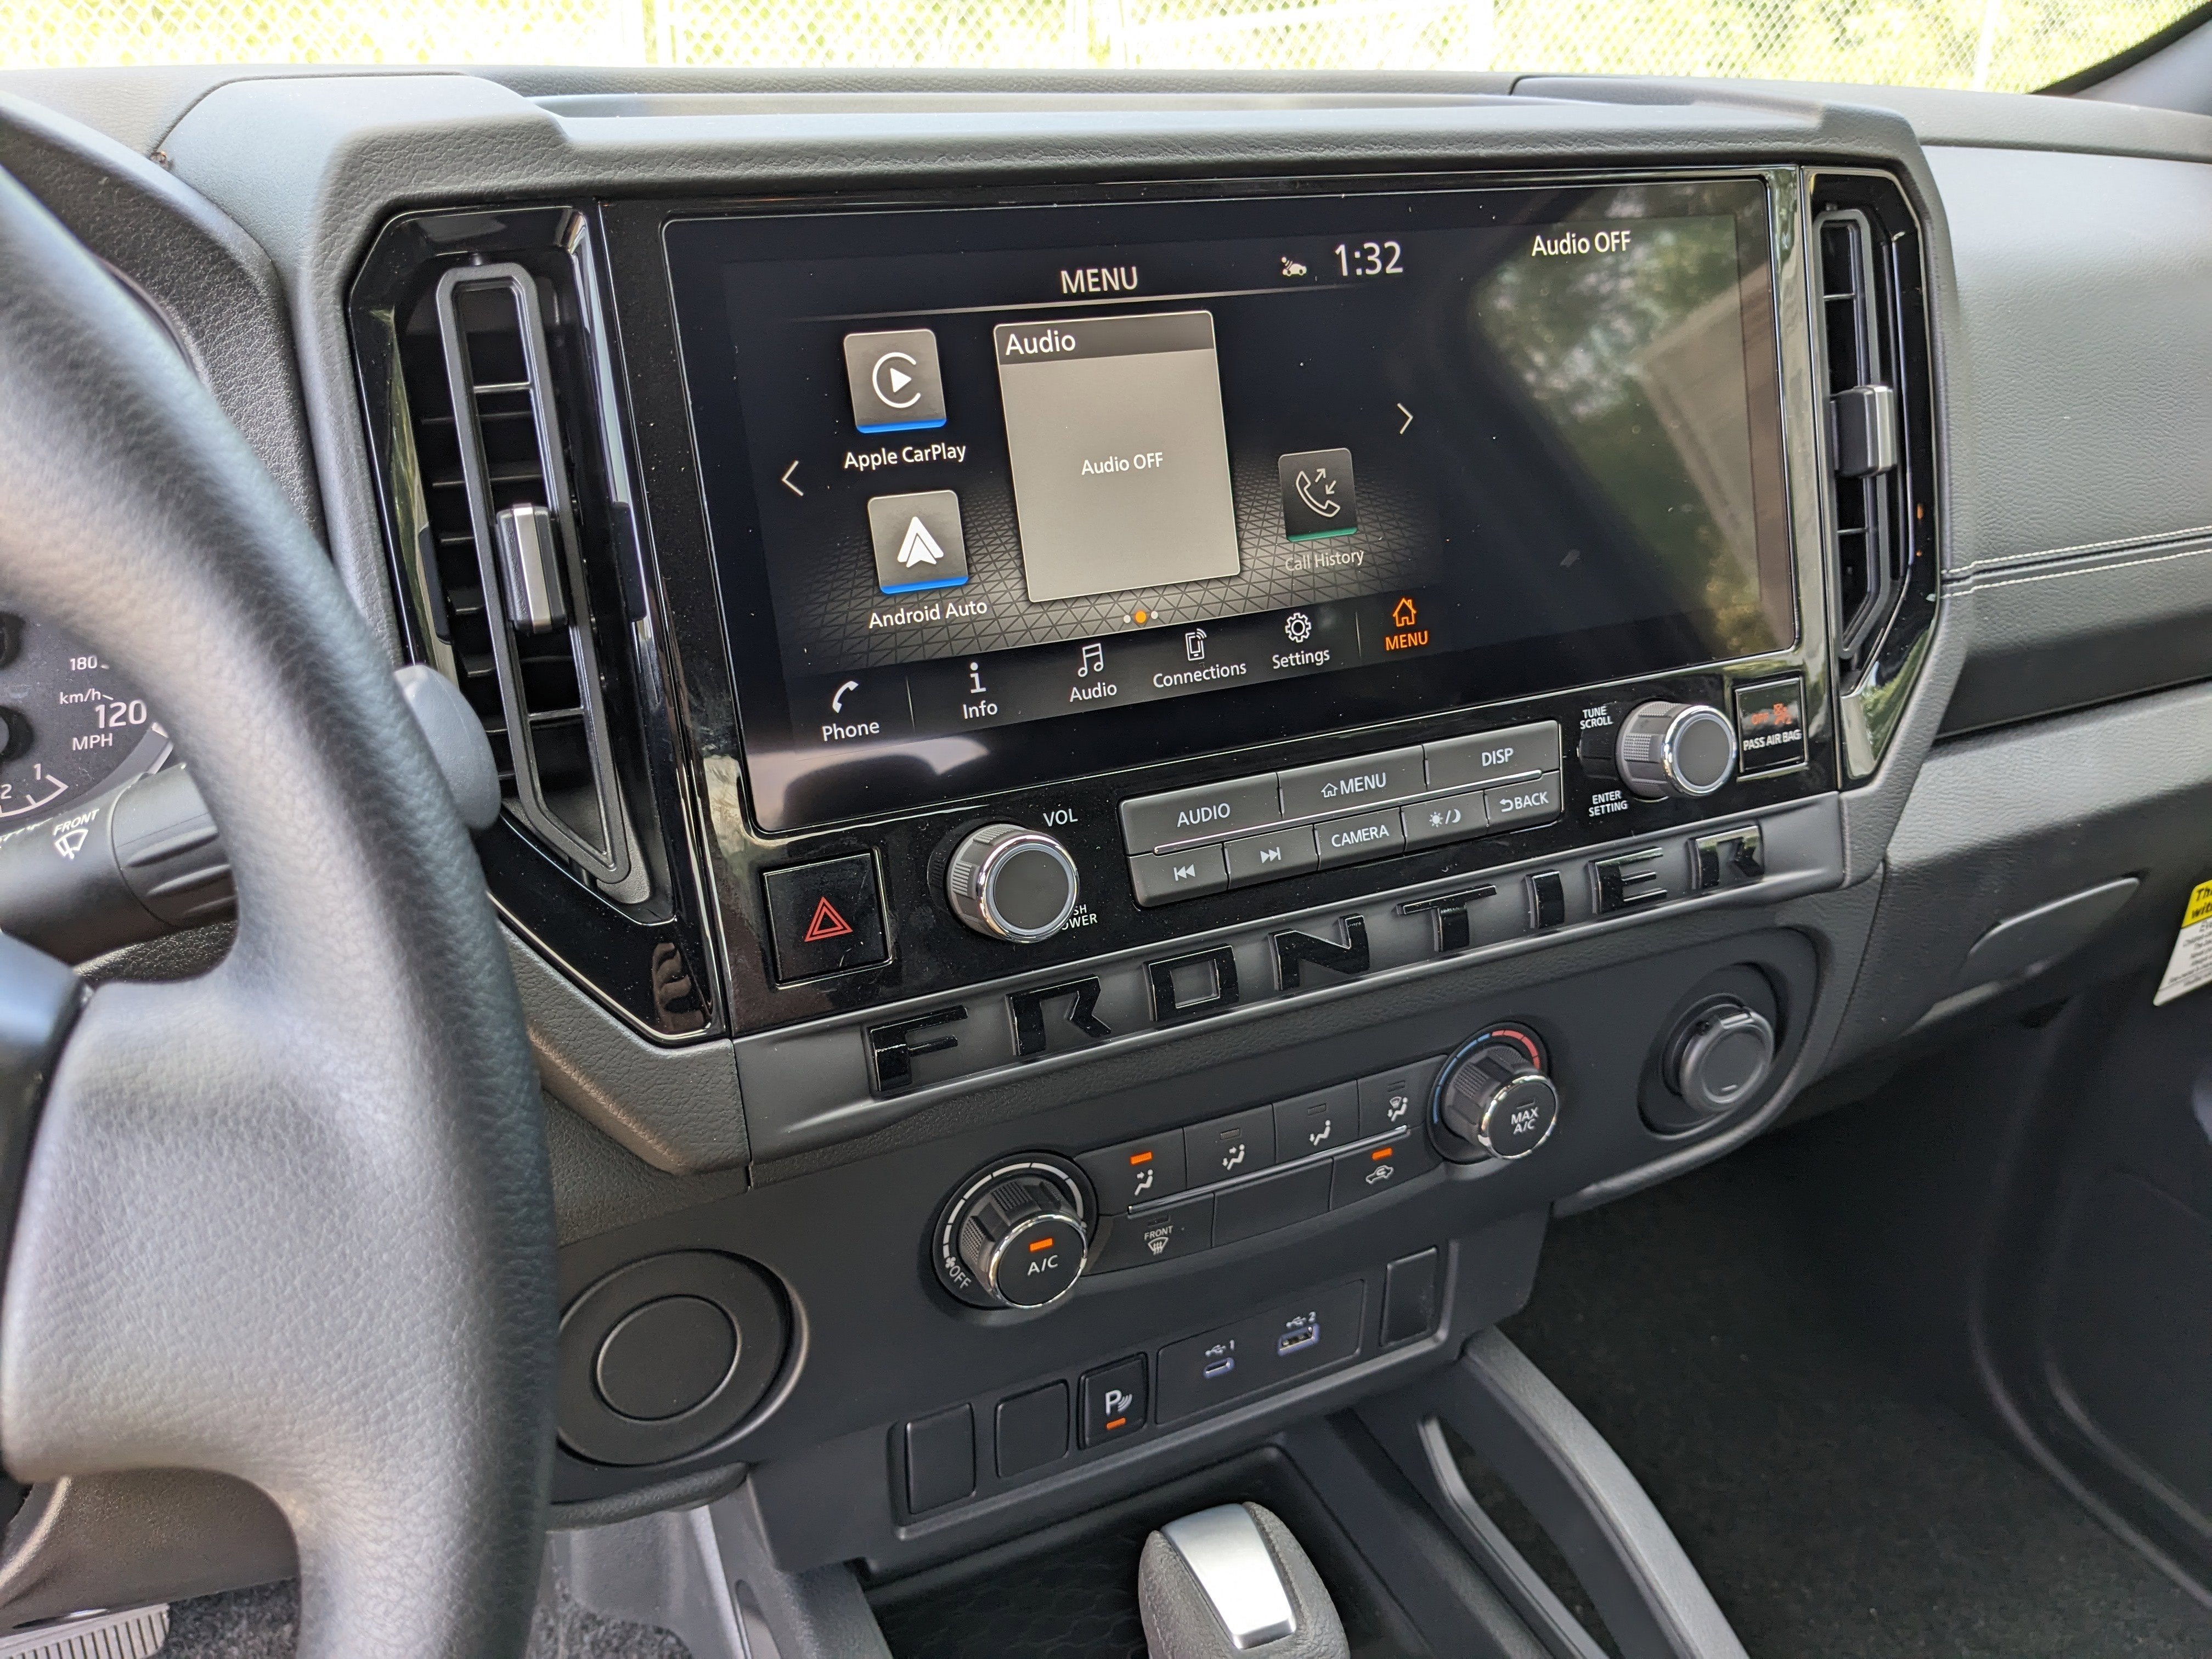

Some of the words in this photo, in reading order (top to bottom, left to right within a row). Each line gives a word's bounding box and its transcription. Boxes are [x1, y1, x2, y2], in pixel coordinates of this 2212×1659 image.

[1531, 232, 1590, 257] Audio
[1594, 230, 1632, 253] OFF
[1334, 240, 1403, 277] 1:32
[1060, 266, 1138, 294] MENU
[1005, 329, 1076, 356] Audio
[844, 448, 898, 472] Apple
[902, 442, 967, 464] CarPlay
[1081, 455, 1130, 476] Audio
[1133, 452, 1164, 470] OFF
[1285, 554, 1311, 572] Call
[1314, 549, 1364, 568] History
[868, 605, 941, 629] Android
[945, 601, 988, 620] Auto
[1385, 630, 1429, 651] MENU
[70, 655, 98, 671] 180
[1272, 647, 1330, 670] Settings
[1153, 661, 1247, 689] Connections
[59, 688, 101, 705] km/h
[1069, 683, 1118, 703] Audio
[94, 699, 148, 729] 120
[963, 701, 998, 720] Info
[1582, 705, 1607, 719] TUNE
[822, 720, 880, 742] Phone
[1580, 715, 1613, 730] SCROLL
[72, 732, 113, 751] MPH
[1743, 736, 1766, 751] PASS
[1766, 733, 1782, 746] AIR
[1782, 729, 1802, 743] BAG
[1481, 747, 1514, 767] DISP
[1340, 772, 1387, 795] MENU
[1515, 791, 1549, 810] BACK
[1592, 790, 1622, 805] ENTER
[1043, 808, 1078, 827] VOL
[1177, 803, 1231, 827] AUDIO
[1589, 800, 1628, 817] SETTING
[53, 808, 100, 836] FRONT
[1331, 825, 1390, 848] CAMERA
[2197, 887, 2212, 901] Th
[2192, 902, 2212, 918] wit
[1061, 913, 1098, 930] WER
[865, 825, 1767, 1094] FRONTIER
[1511, 1107, 1539, 1125] MAX
[1513, 1118, 1537, 1136] A/C
[1144, 1226, 1173, 1240] FRONT
[1027, 1255, 1059, 1277] A/C
[949, 1265, 972, 1290] OFF
[1308, 1311, 1316, 1323] 2
